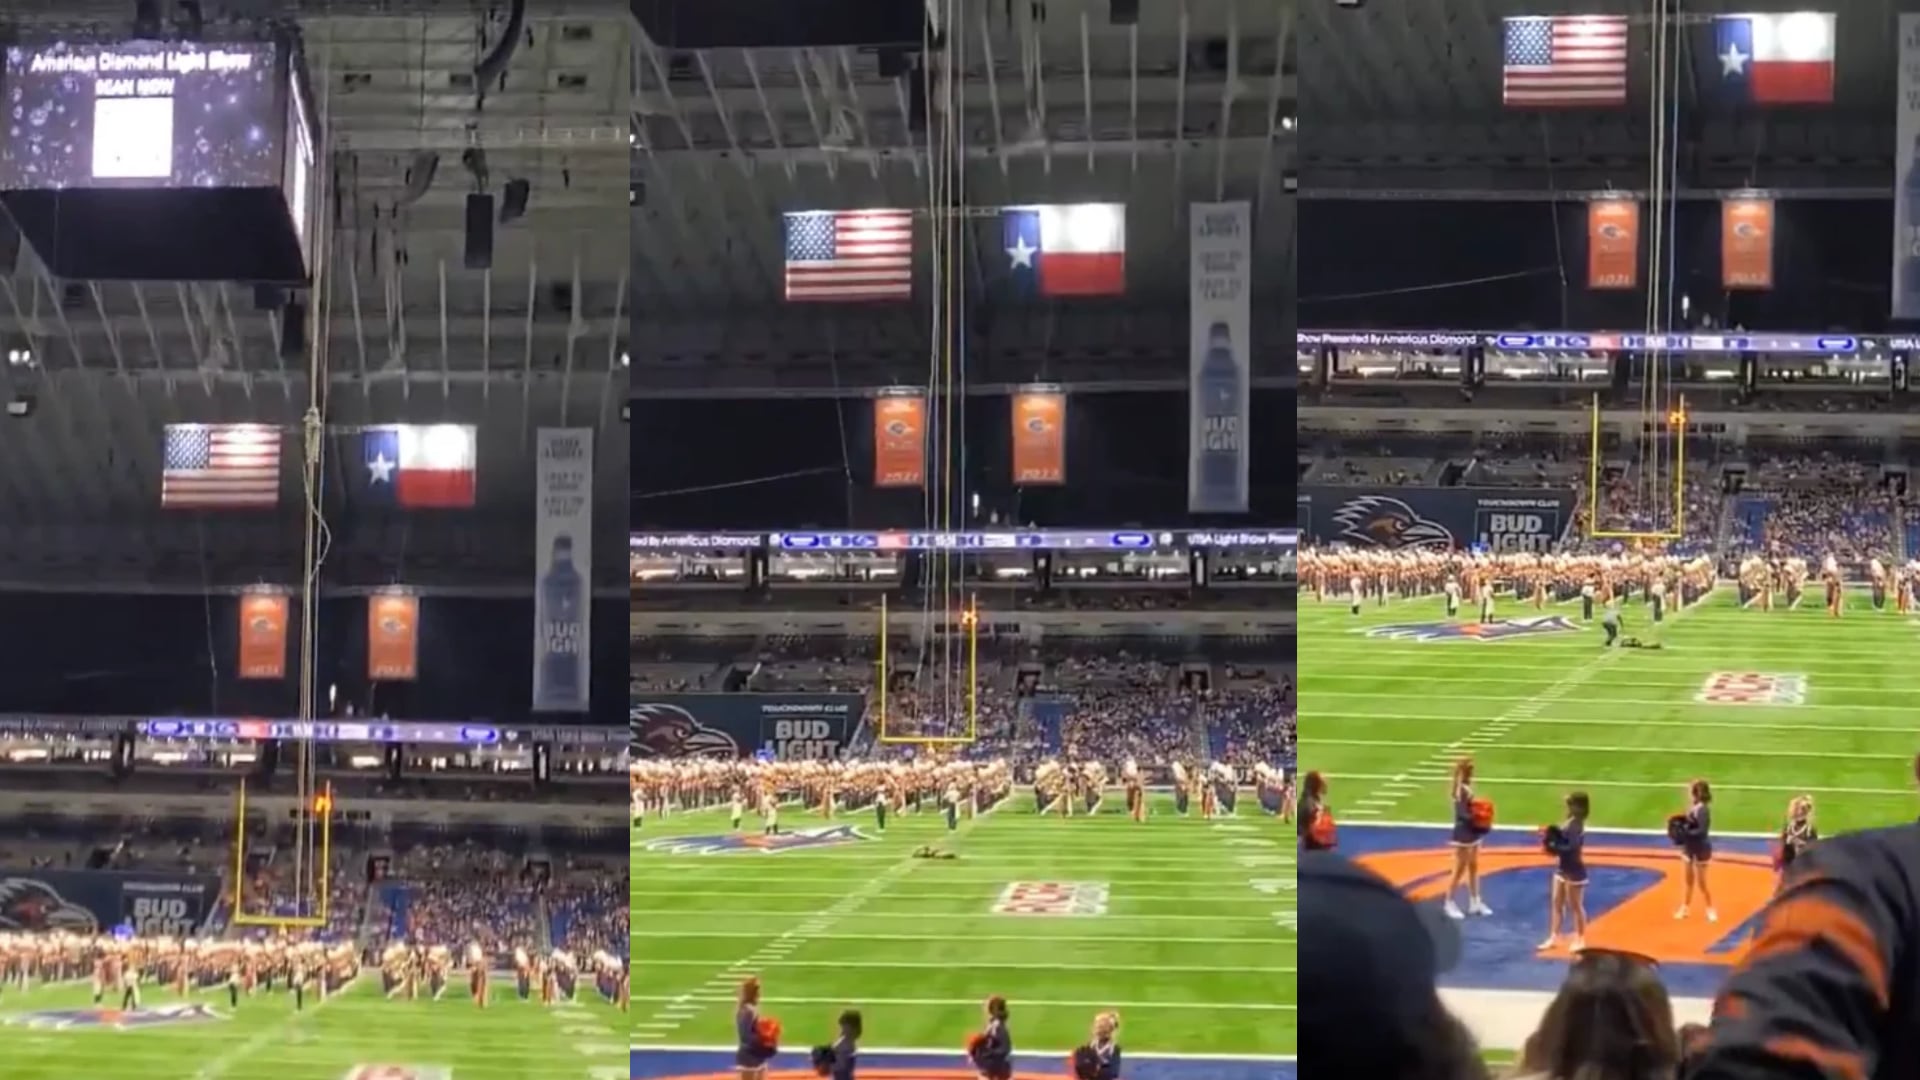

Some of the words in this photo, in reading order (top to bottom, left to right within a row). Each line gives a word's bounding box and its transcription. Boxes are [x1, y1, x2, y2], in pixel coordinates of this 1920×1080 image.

[99, 52, 164, 71] Diamond
[167, 52, 205, 73] Light
[208, 51, 252, 71] Show
[1322, 333, 1369, 344] Presented
[1370, 333, 1380, 346] By
[1382, 333, 1428, 345] Americus
[1429, 333, 1476, 345] Diamond
[1490, 513, 1542, 533] BUD
[661, 535, 709, 547] Americus
[711, 535, 760, 547] Diamond
[775, 719, 830, 739] BUD
[134, 898, 187, 919] BUD
